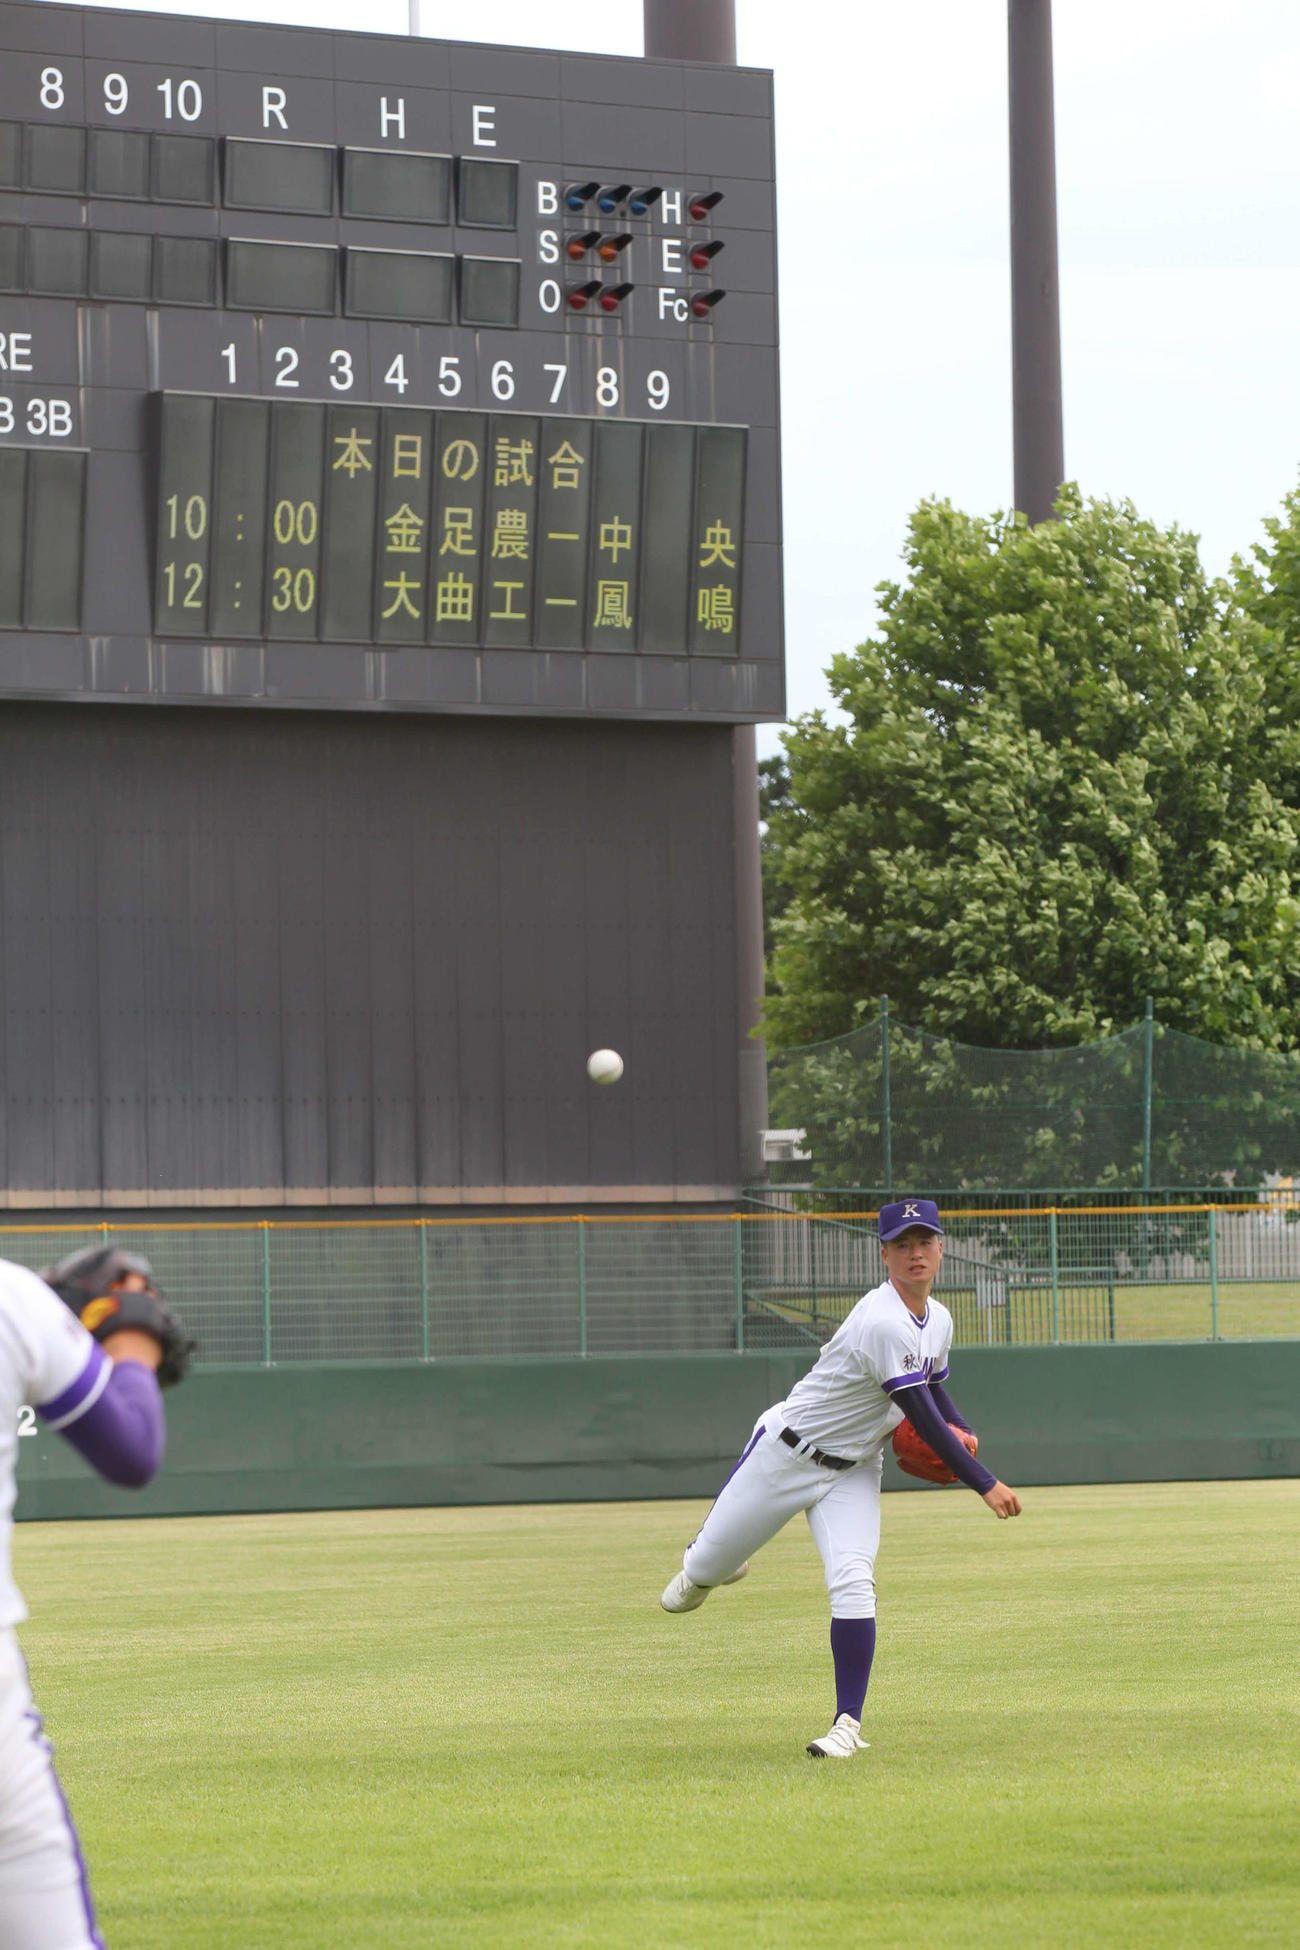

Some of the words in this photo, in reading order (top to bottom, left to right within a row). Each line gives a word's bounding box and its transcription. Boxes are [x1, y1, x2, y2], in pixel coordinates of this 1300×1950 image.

[39, 66, 65, 110] 8
[103, 72, 129, 115] 9
[156, 78, 202, 122] 10
[262, 86, 289, 131] R
[380, 96, 406, 140] H
[472, 105, 497, 148] E
[537, 181, 559, 215] B
[661, 190, 682, 225] H
[539, 229, 560, 264] S
[662, 238, 683, 273] E
[658, 287, 689, 322] Fc
[221, 343, 236, 384] 1
[275, 346, 300, 389] 2
[329, 349, 354, 392] 3
[384, 353, 409, 394] 4
[438, 356, 462, 397] 5
[491, 360, 515, 401] 6
[543, 363, 567, 404] 7
[596, 367, 619, 407] 8
[646, 370, 670, 410] 9
[26, 398, 73, 437] 3B
[332, 428, 585, 489] 本日の試合
[902, 1203, 921, 1218] K
[17, 1405, 38, 1436] 2
